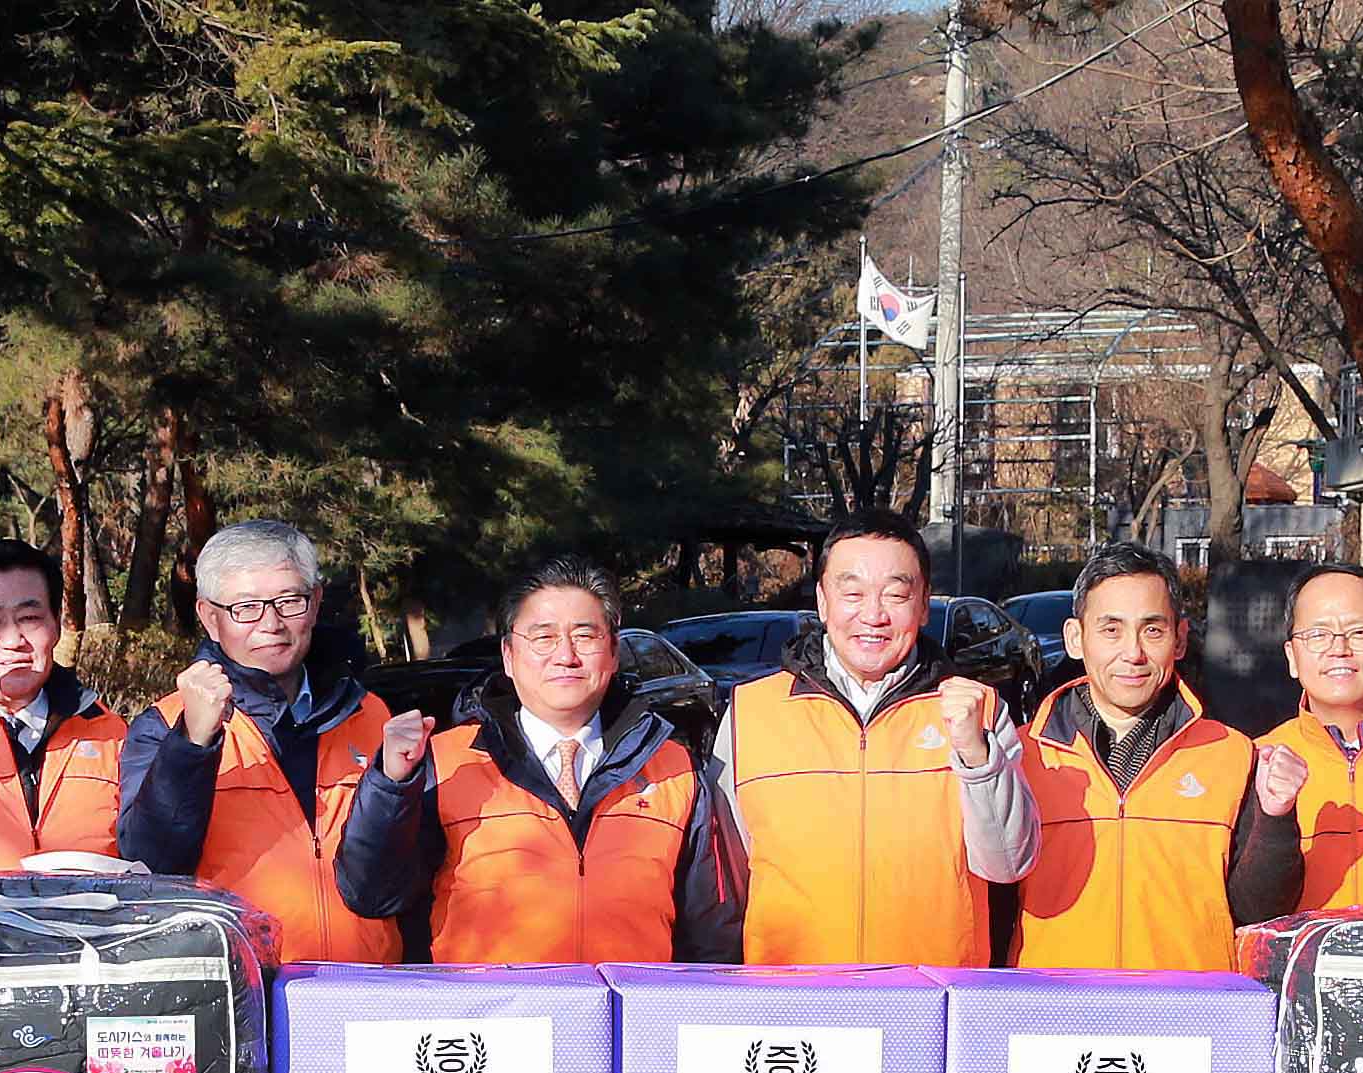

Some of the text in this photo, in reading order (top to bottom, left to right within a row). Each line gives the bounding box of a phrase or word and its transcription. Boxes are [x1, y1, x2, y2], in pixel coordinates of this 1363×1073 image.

[97, 1031, 151, 1043] 도시가스와
[140, 1046, 185, 1058] 겨울나기
[434, 1038, 469, 1072] 증
